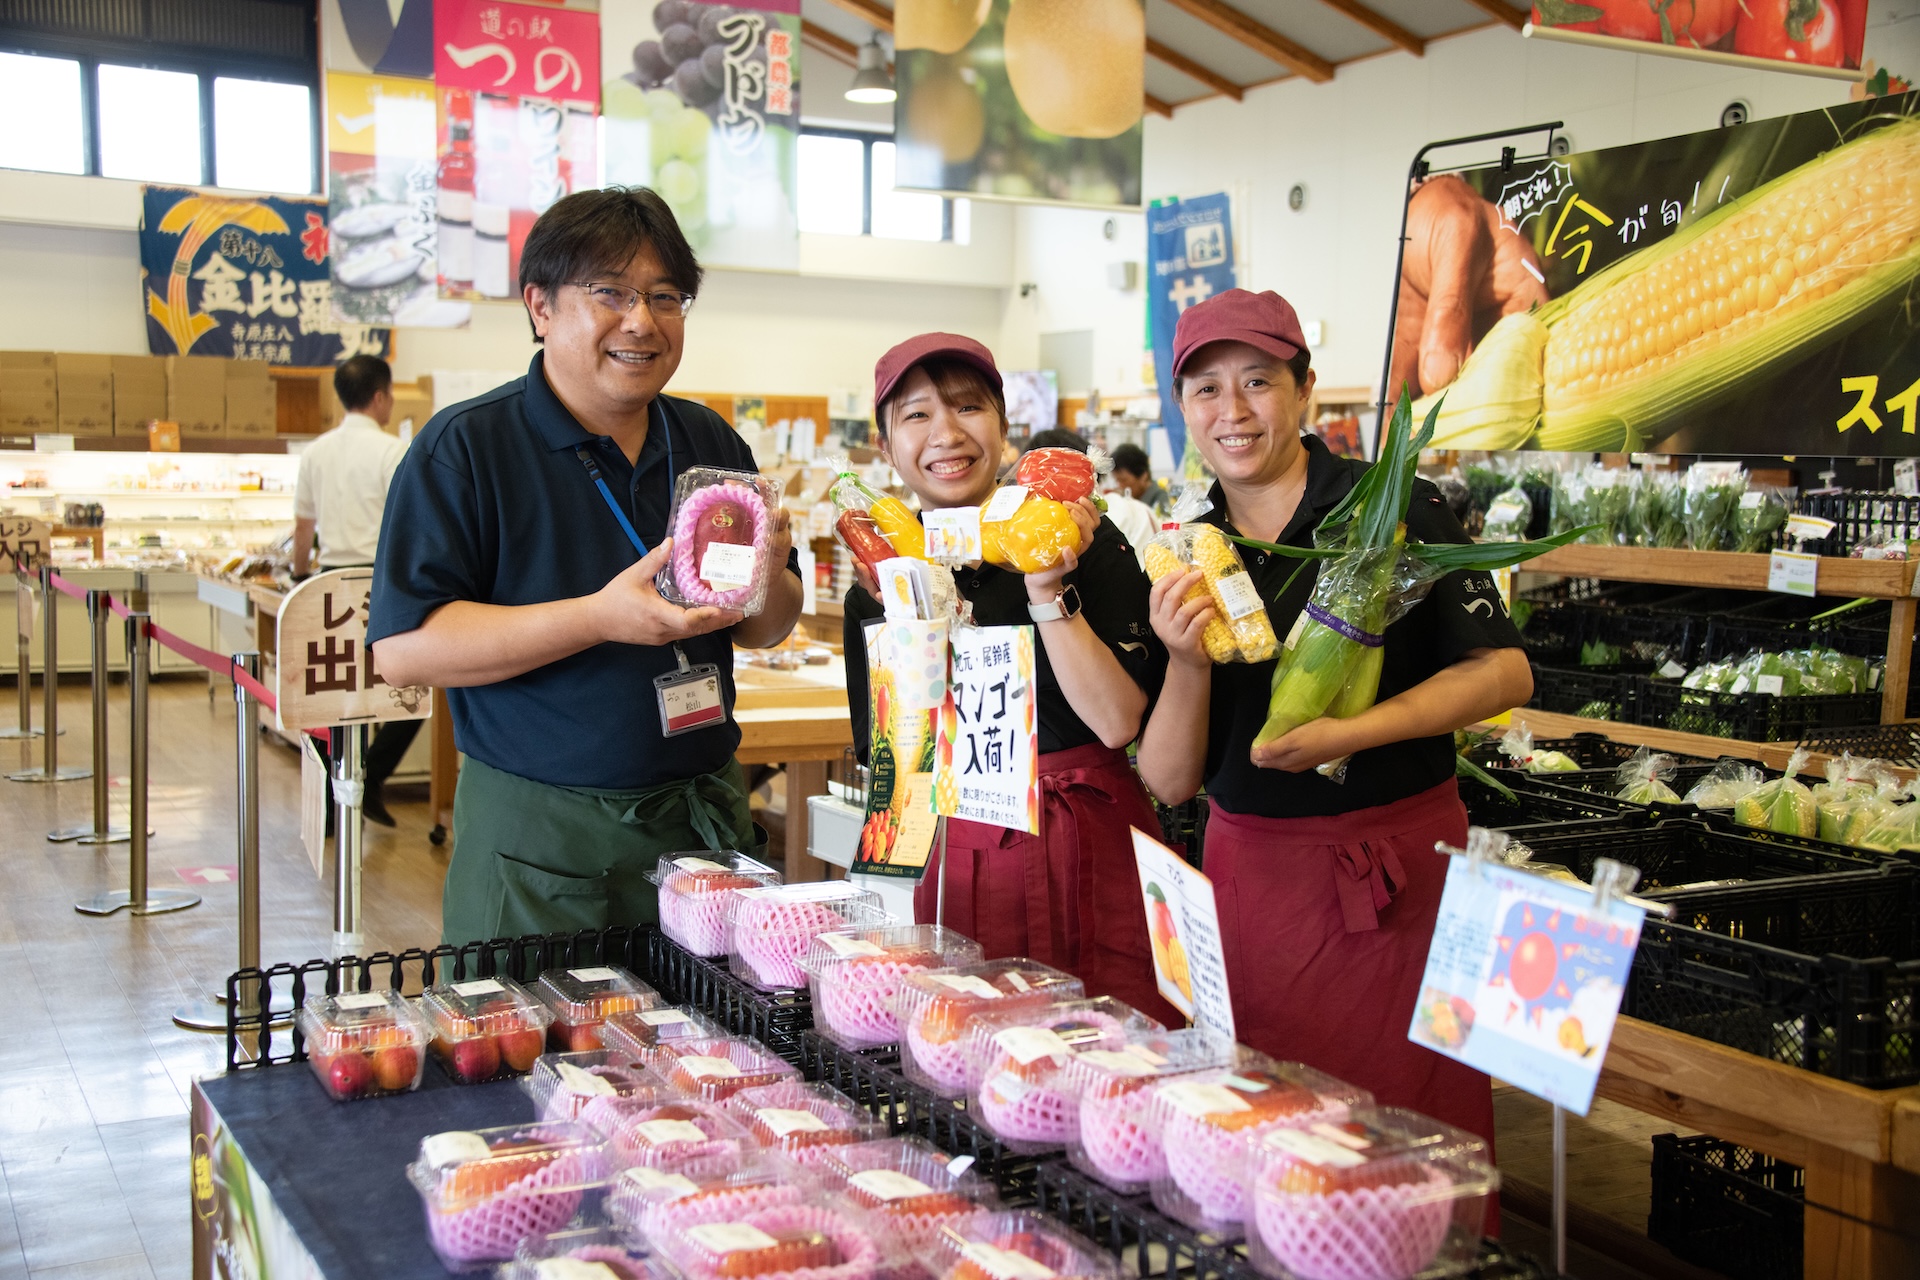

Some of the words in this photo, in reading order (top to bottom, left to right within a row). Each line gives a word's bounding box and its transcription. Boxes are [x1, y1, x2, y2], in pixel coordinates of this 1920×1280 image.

[480, 8, 553, 43] 道の駅
[444, 42, 582, 93] つの
[717, 14, 766, 155] ブドウ
[219, 229, 284, 268] 第十八
[324, 591, 372, 631] レ
[953, 672, 1025, 724] マンゴー
